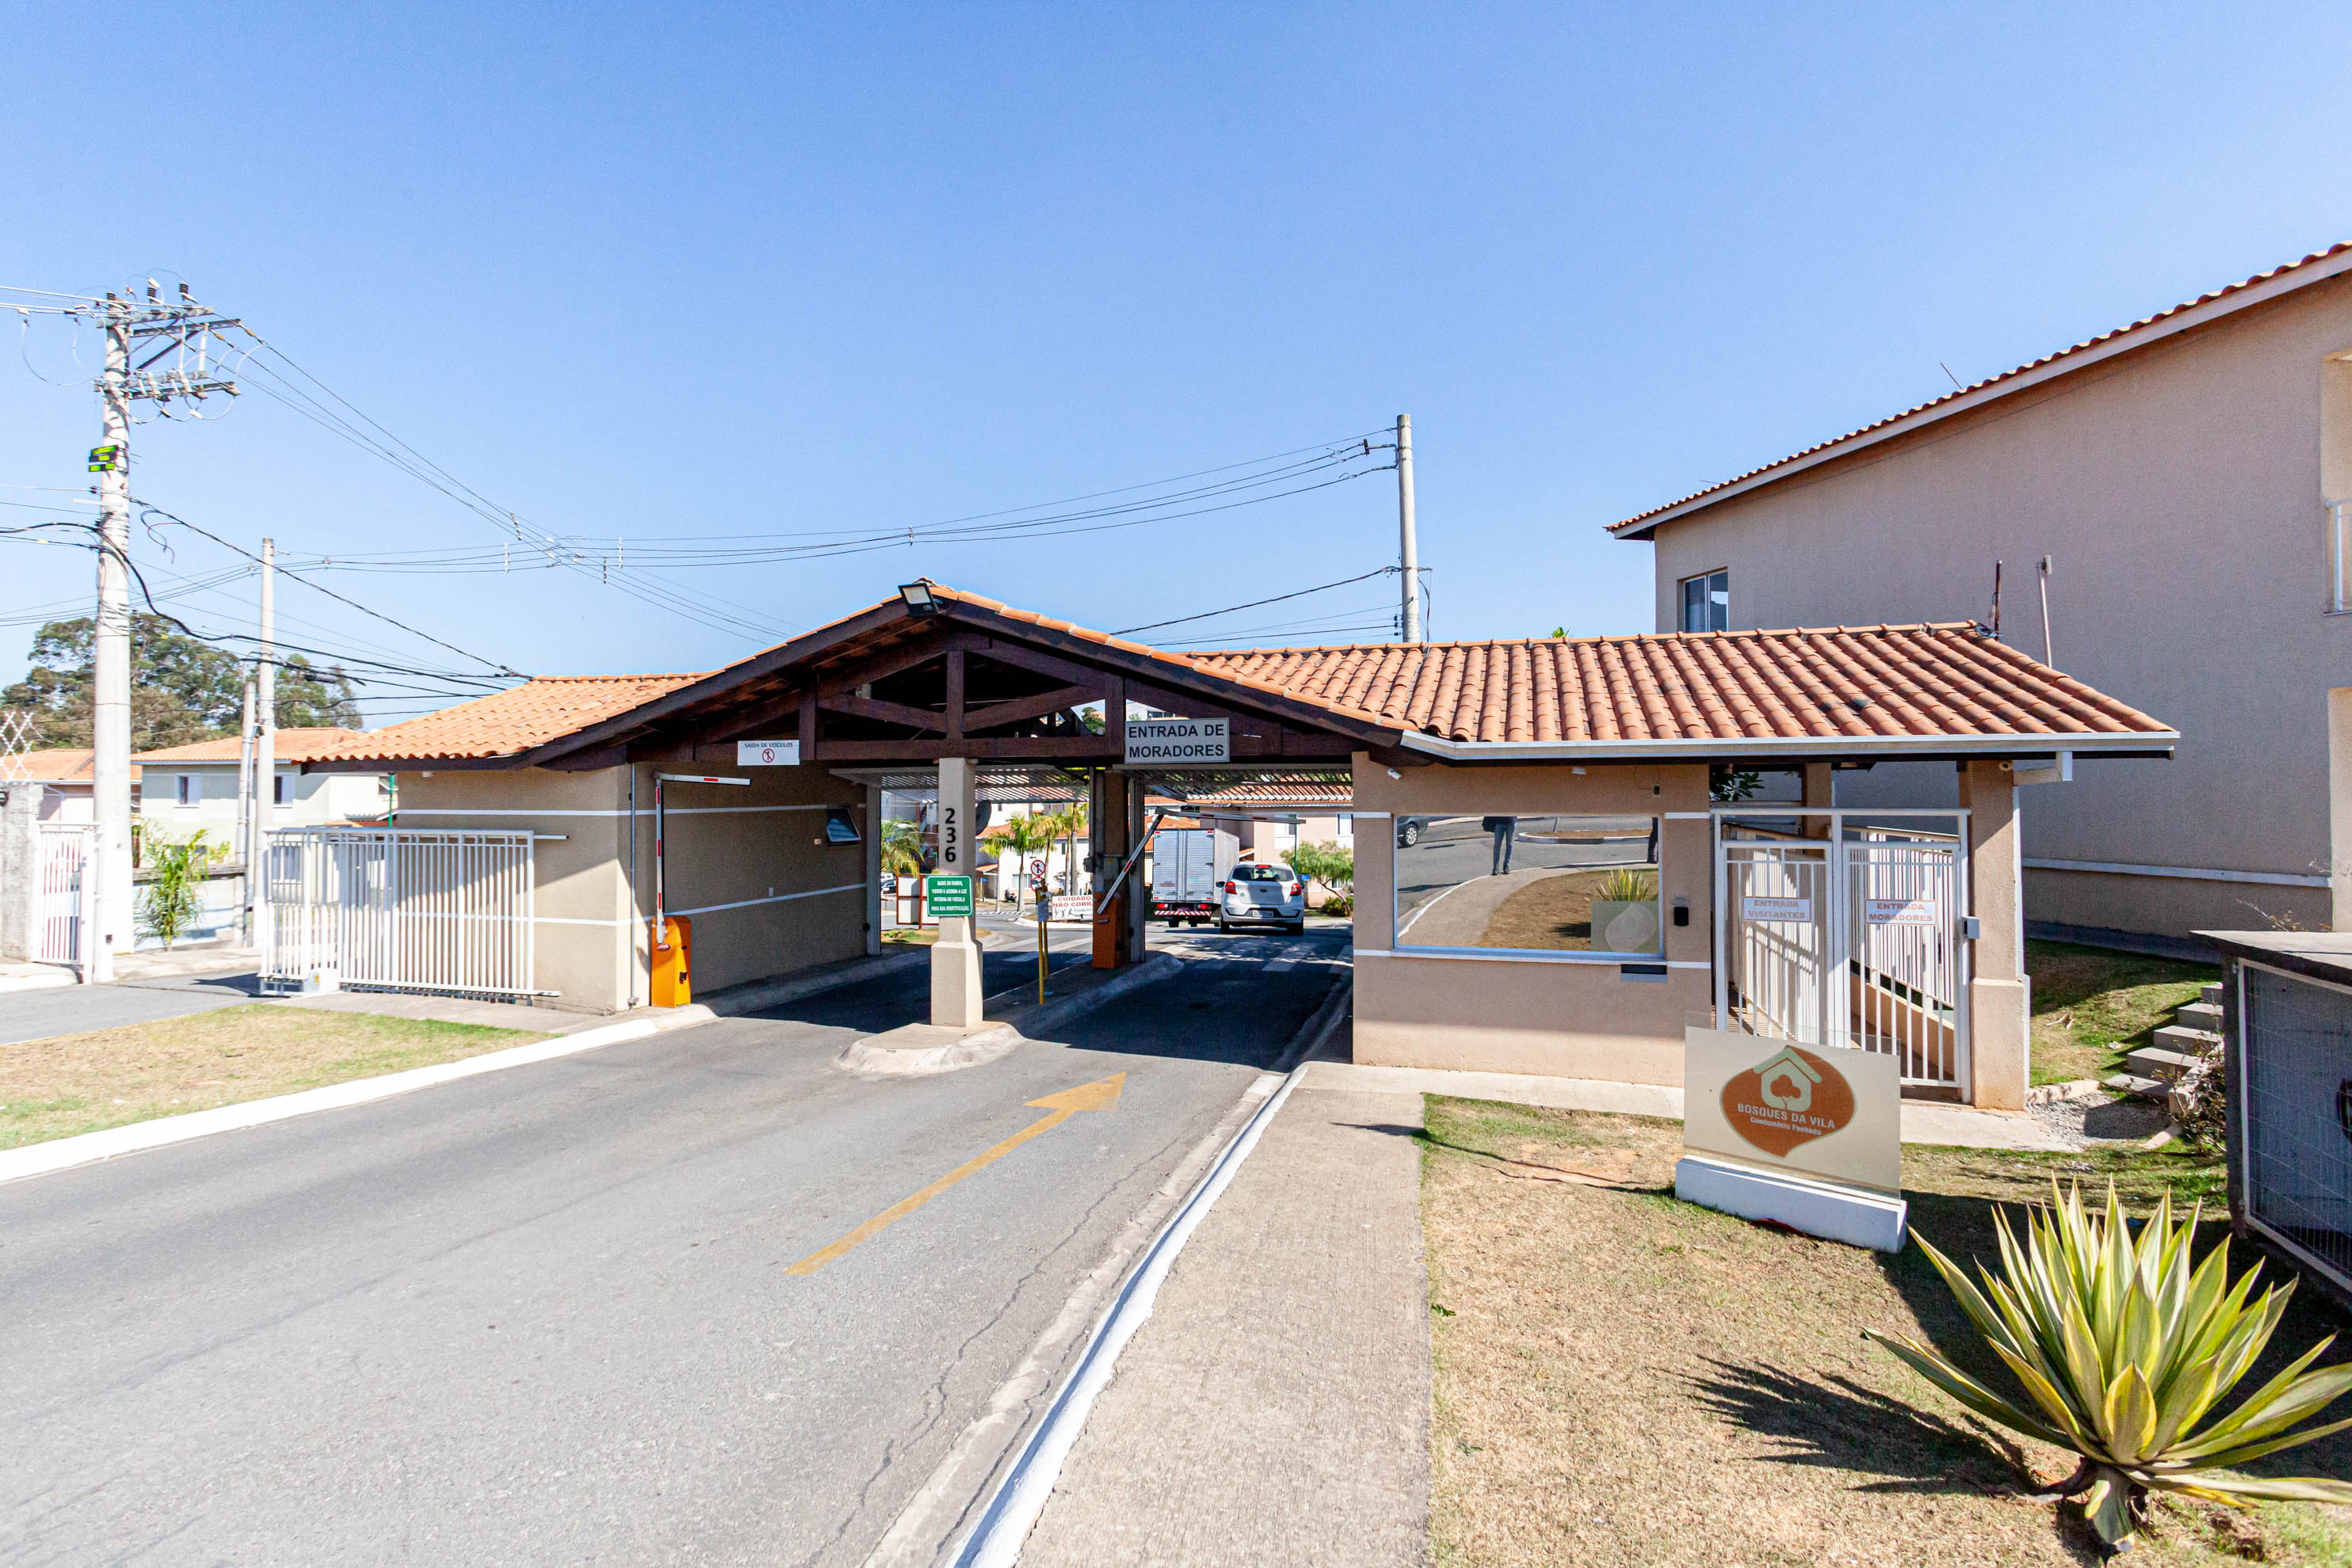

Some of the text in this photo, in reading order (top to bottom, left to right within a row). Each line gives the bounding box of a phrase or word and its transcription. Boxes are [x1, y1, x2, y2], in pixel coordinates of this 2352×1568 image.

[1128, 724, 1224, 738] ENTRADA DE
[1128, 744, 1224, 758] MORADORES
[945, 808, 957, 862] 236
[1737, 1103, 1836, 1129] BOSQUES DA VILA
[1792, 1124, 1821, 1136] Fechado
